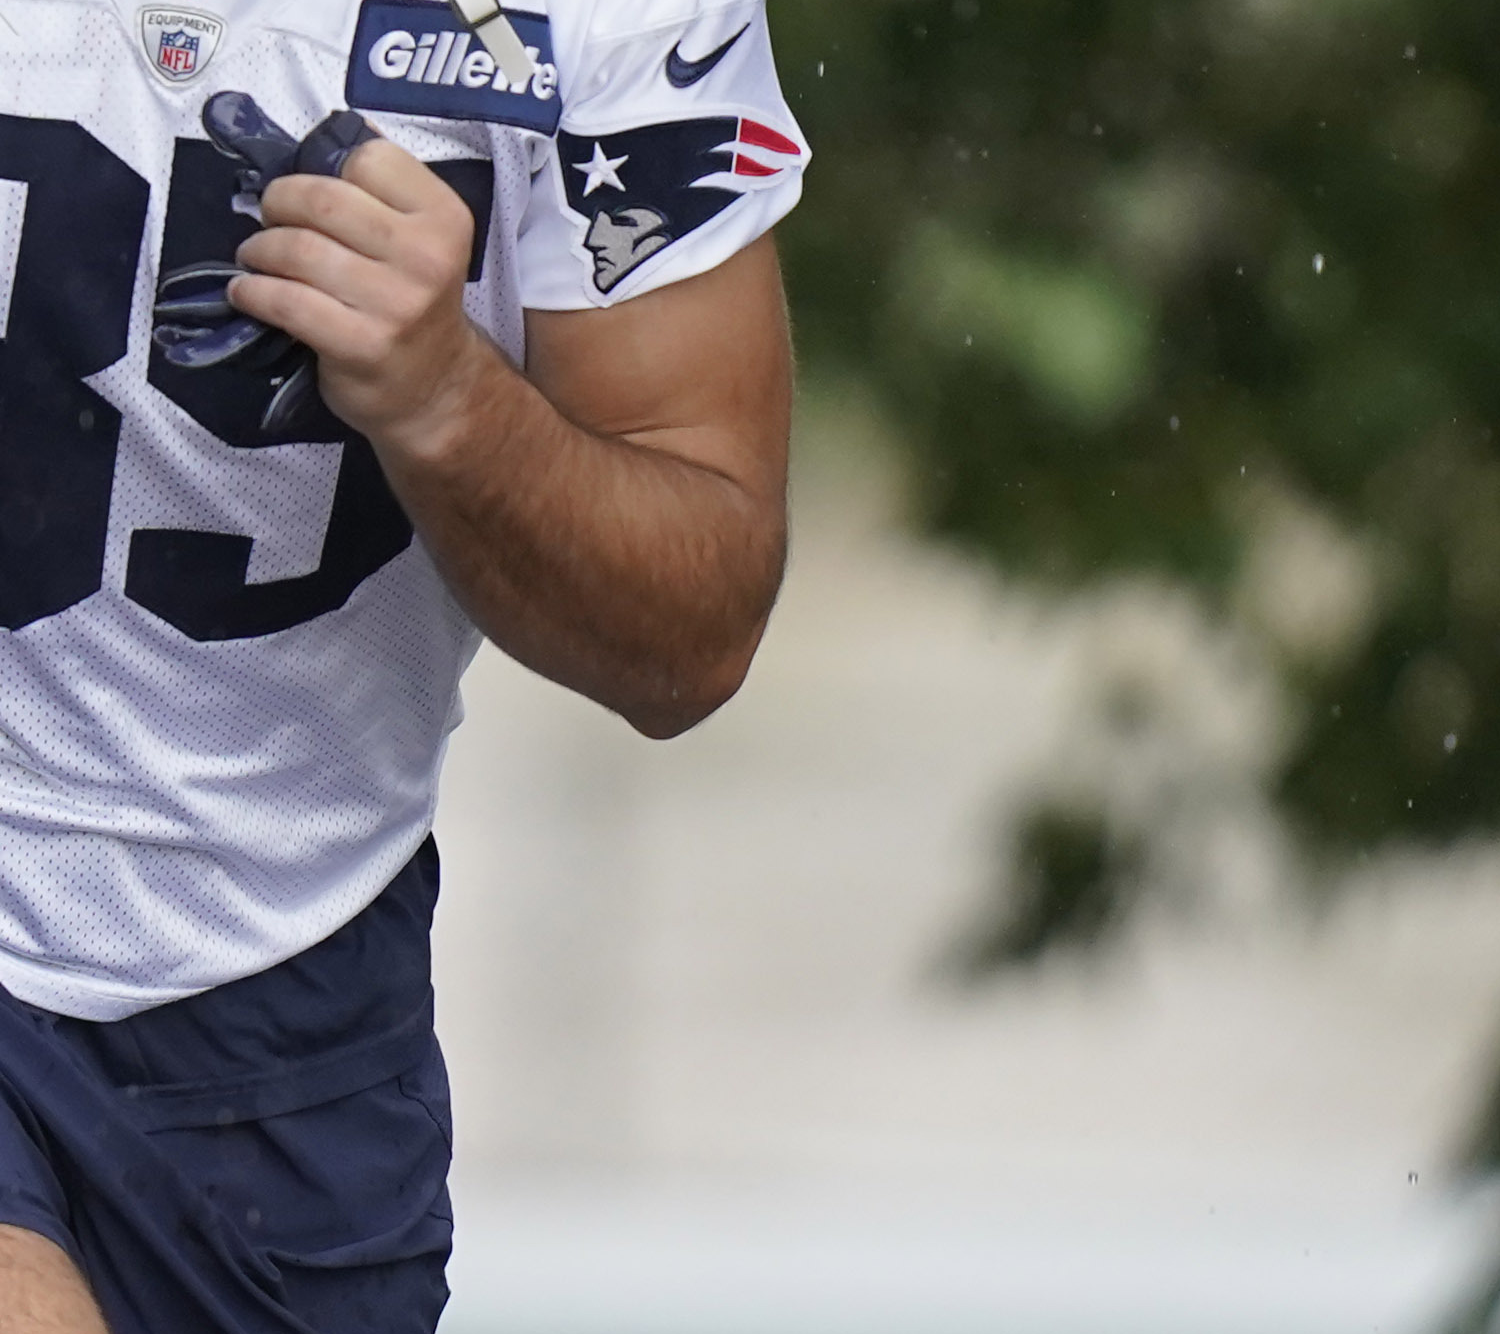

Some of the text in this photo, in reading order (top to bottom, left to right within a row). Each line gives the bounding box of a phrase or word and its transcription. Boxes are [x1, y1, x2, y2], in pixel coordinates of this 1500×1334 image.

[147, 13, 217, 35] EQUIPMENT
[161, 47, 193, 71] NFL
[368, 29, 559, 101] Gillee
